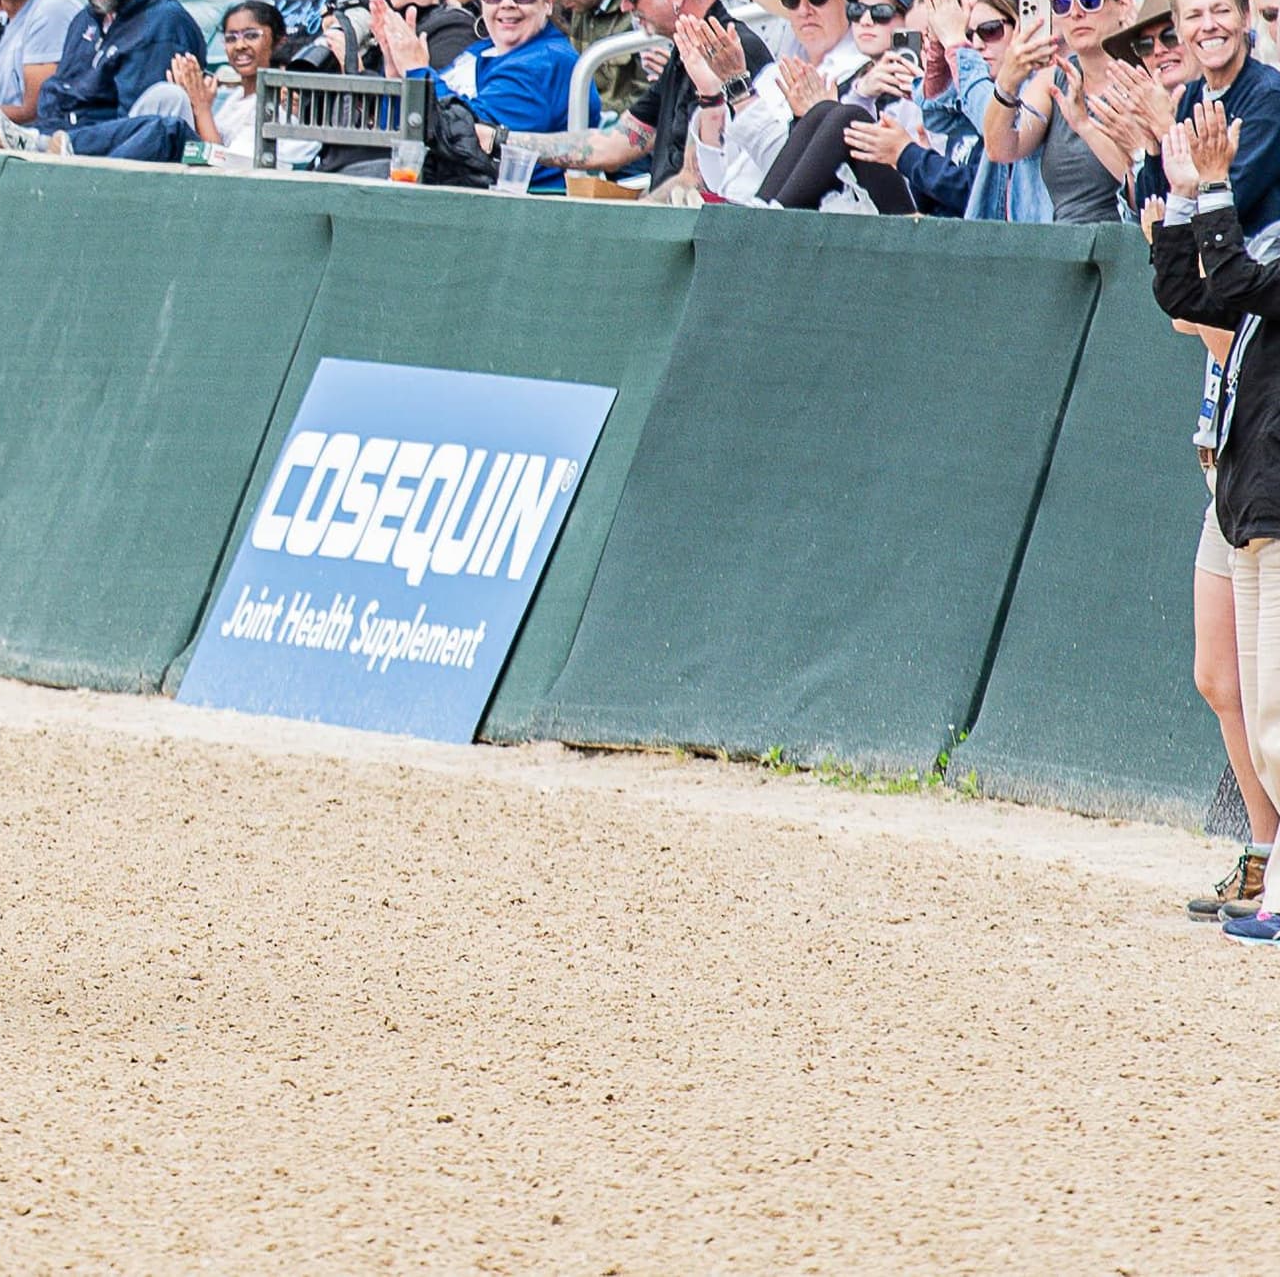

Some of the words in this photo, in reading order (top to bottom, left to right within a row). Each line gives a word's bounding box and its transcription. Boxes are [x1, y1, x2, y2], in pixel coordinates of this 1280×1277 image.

[221, 584, 286, 638] Joint
[277, 590, 356, 653] Health
[348, 599, 487, 673] Supplement
